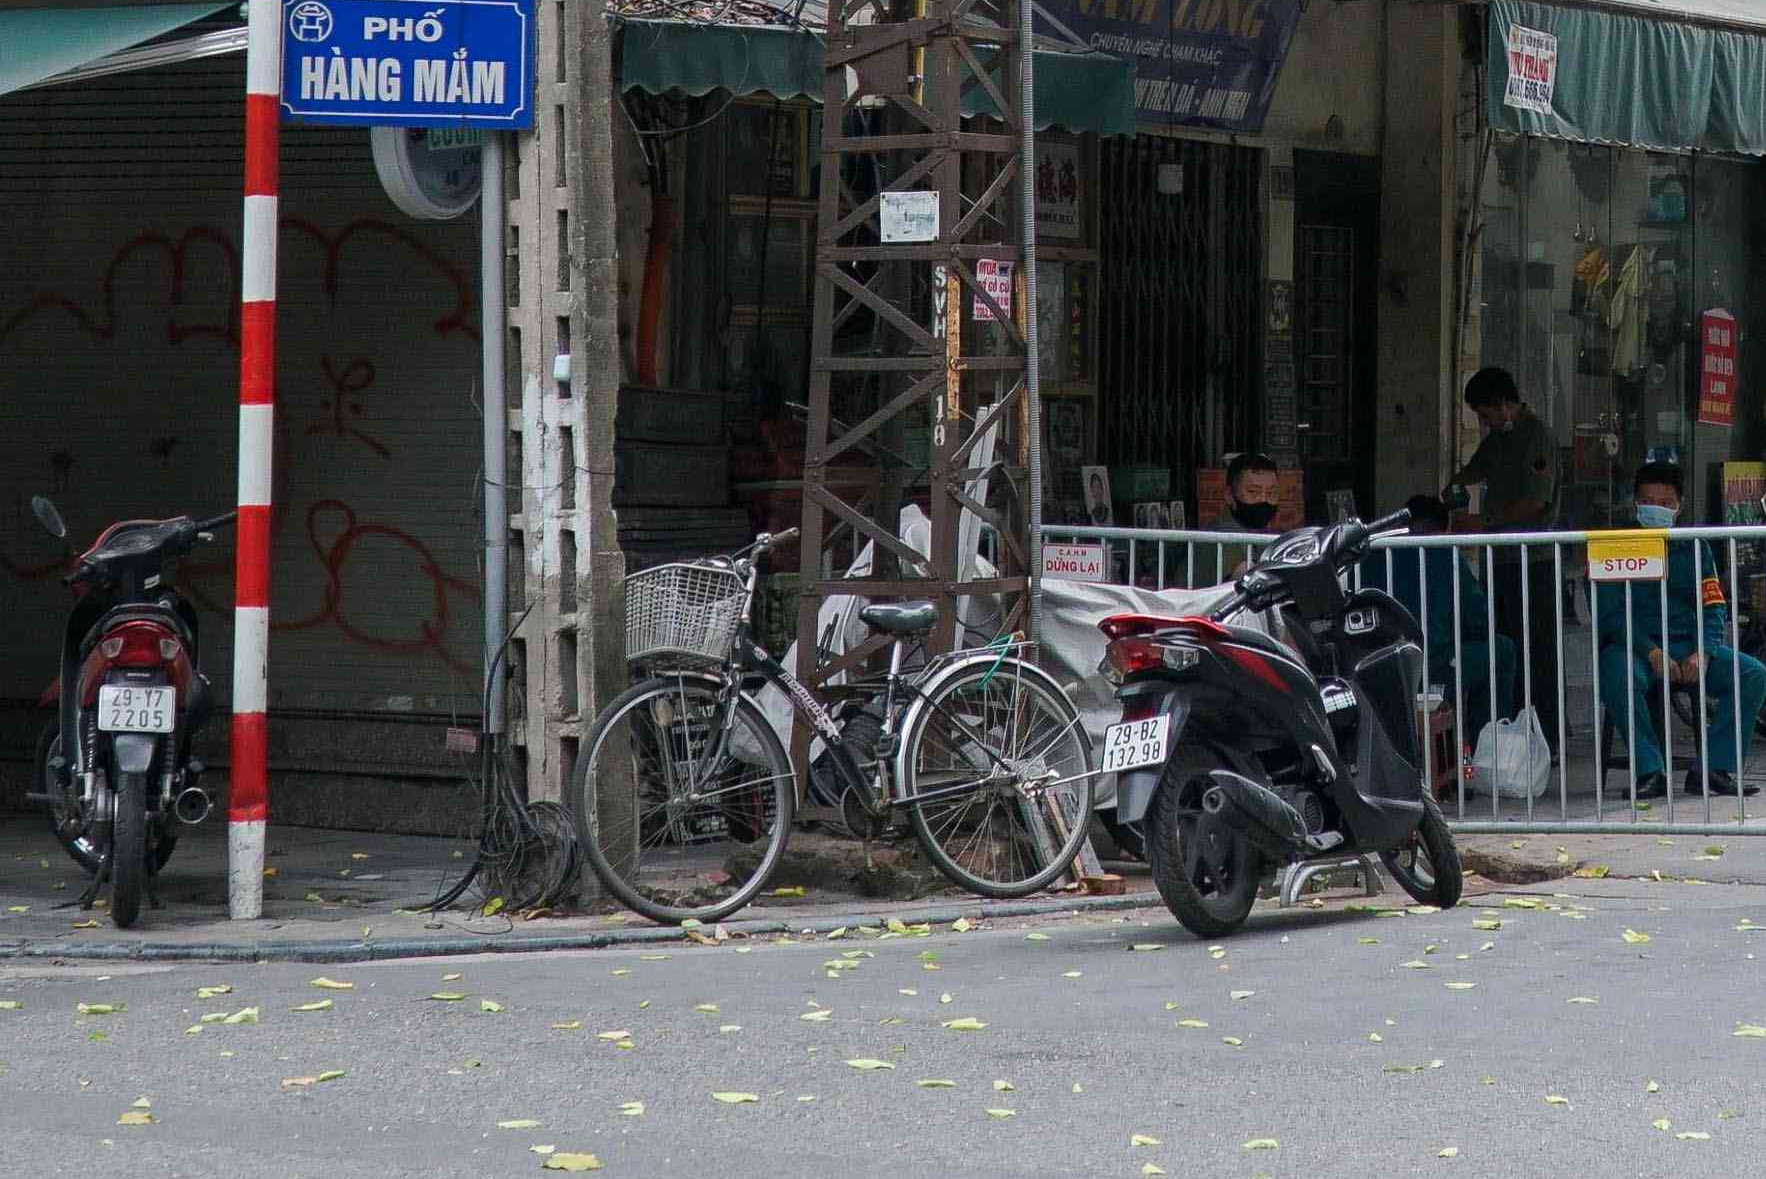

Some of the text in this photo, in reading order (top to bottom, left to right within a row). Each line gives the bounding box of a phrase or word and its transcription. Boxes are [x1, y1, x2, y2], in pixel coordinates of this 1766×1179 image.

[364, 8, 447, 42] PHỐ
[301, 46, 505, 104] HÀNG MẮM
[1604, 558, 1648, 571] STOP
[112, 689, 163, 708] 29-Y7
[111, 709, 163, 728] 2205
[1113, 720, 1159, 746] 29-B2
[1109, 741, 1160, 769] 132.98
